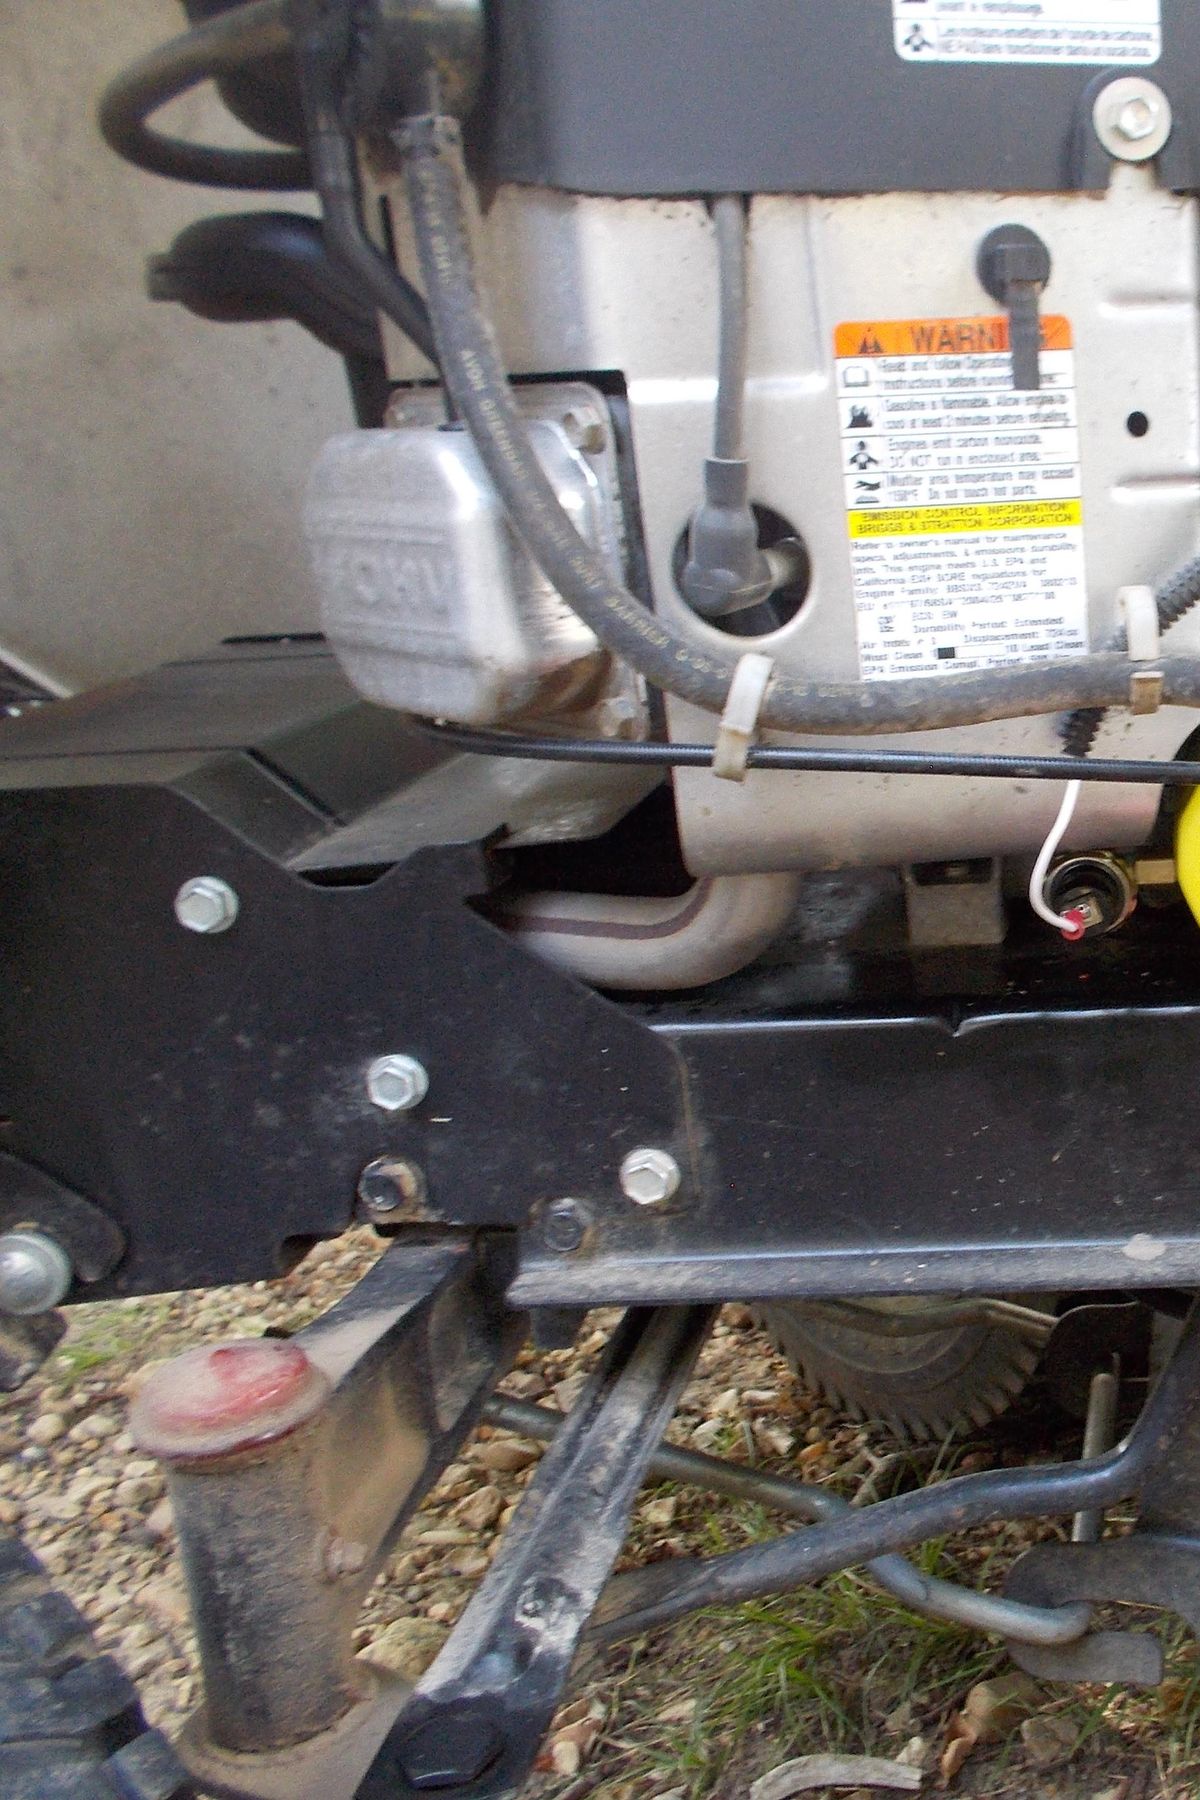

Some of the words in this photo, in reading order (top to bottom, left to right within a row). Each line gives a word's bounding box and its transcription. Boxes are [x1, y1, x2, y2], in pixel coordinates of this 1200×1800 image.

[912, 322, 1044, 351] WARNI
[957, 436, 987, 447] carbon
[862, 510, 916, 521] EMISSION
[923, 507, 981, 518] CONTROL
[988, 503, 1066, 515] INFORMATION
[857, 523, 903, 534] BRIGGS
[922, 519, 980, 531] STRATTON
[989, 514, 1071, 527] CORPORATION
[944, 536, 978, 545] manual
[1003, 531, 1066, 542] maintenance
[908, 562, 940, 572] engine
[948, 560, 974, 570] meets
[1030, 556, 1046, 565] and
